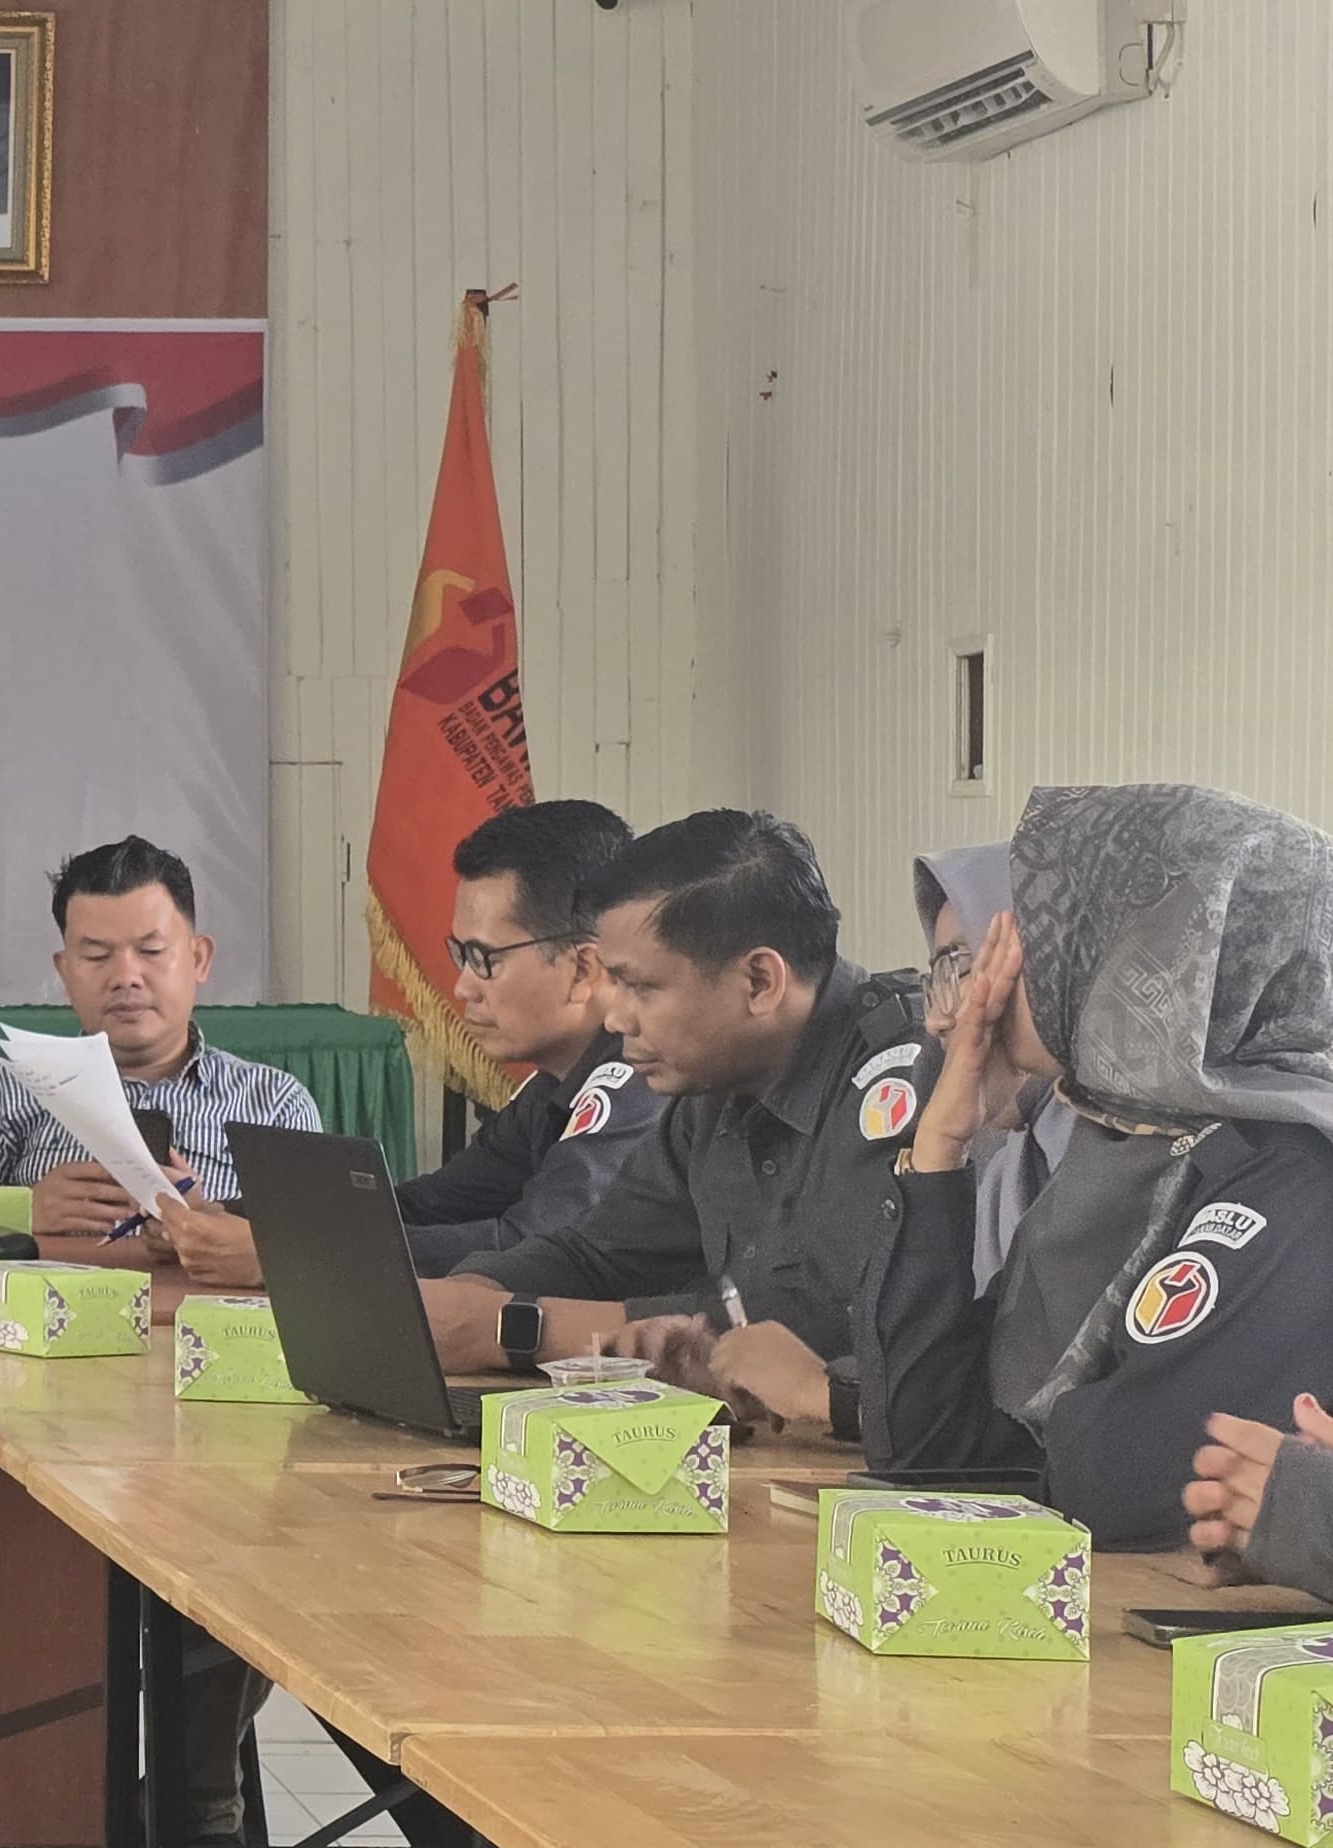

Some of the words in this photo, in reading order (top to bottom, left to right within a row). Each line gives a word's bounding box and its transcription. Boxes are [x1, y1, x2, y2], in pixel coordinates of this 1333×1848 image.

[458, 700, 491, 737] BADAN
[437, 711, 499, 790] KABUPATEN
[220, 1324, 277, 1340] TAURUS
[611, 1424, 678, 1444] TAURUS
[941, 1545, 1023, 1567] TAURUS
